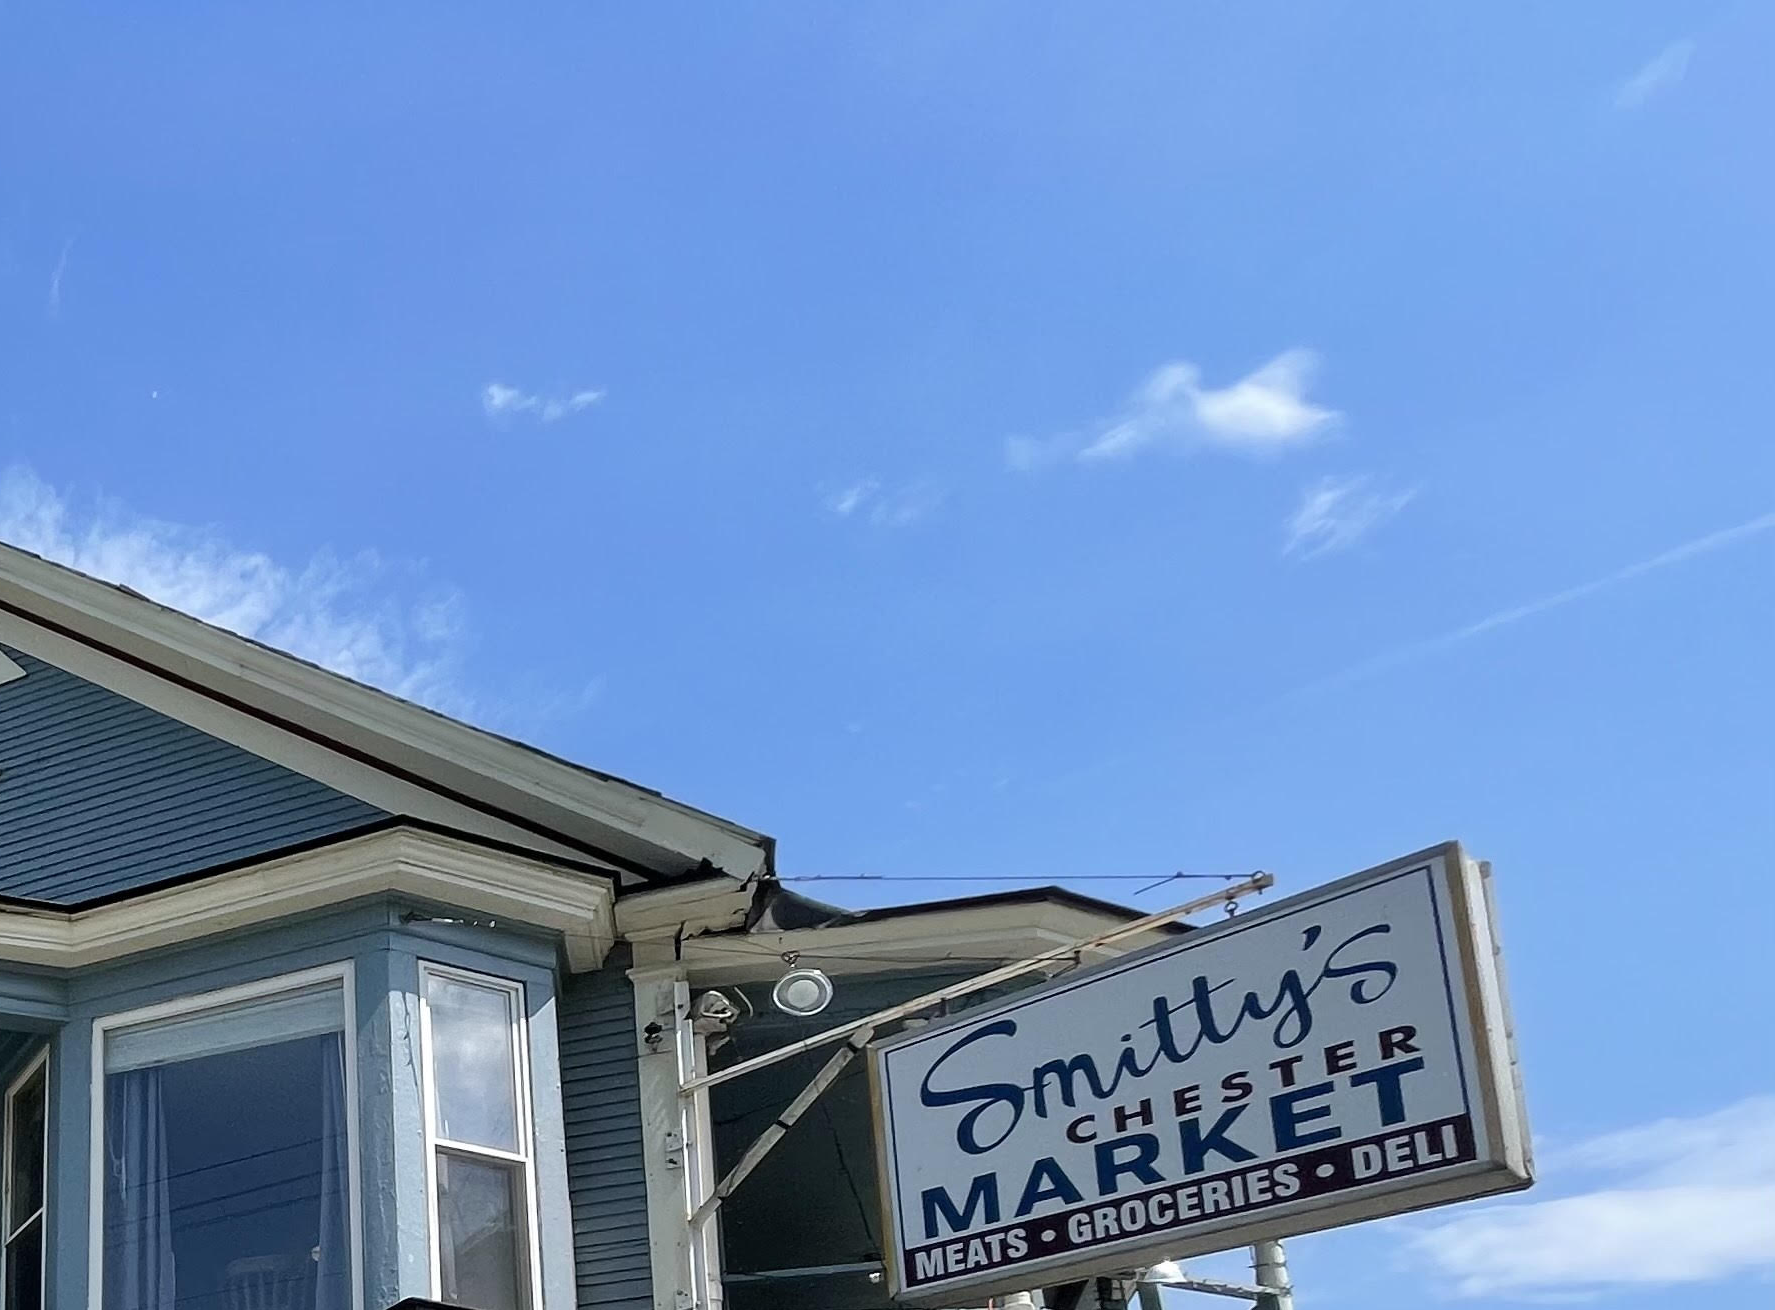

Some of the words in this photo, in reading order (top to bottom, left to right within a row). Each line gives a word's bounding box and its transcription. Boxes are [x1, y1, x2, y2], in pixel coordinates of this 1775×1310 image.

[920, 924, 1398, 1155] Smitty's
[1066, 1025, 1421, 1143] CHESTER
[914, 1228, 1029, 1280] MEATS
[1068, 1162, 1302, 1245] GROCERIES
[1351, 1125, 1460, 1180] DELI
[921, 1056, 1425, 1239] MARKET
